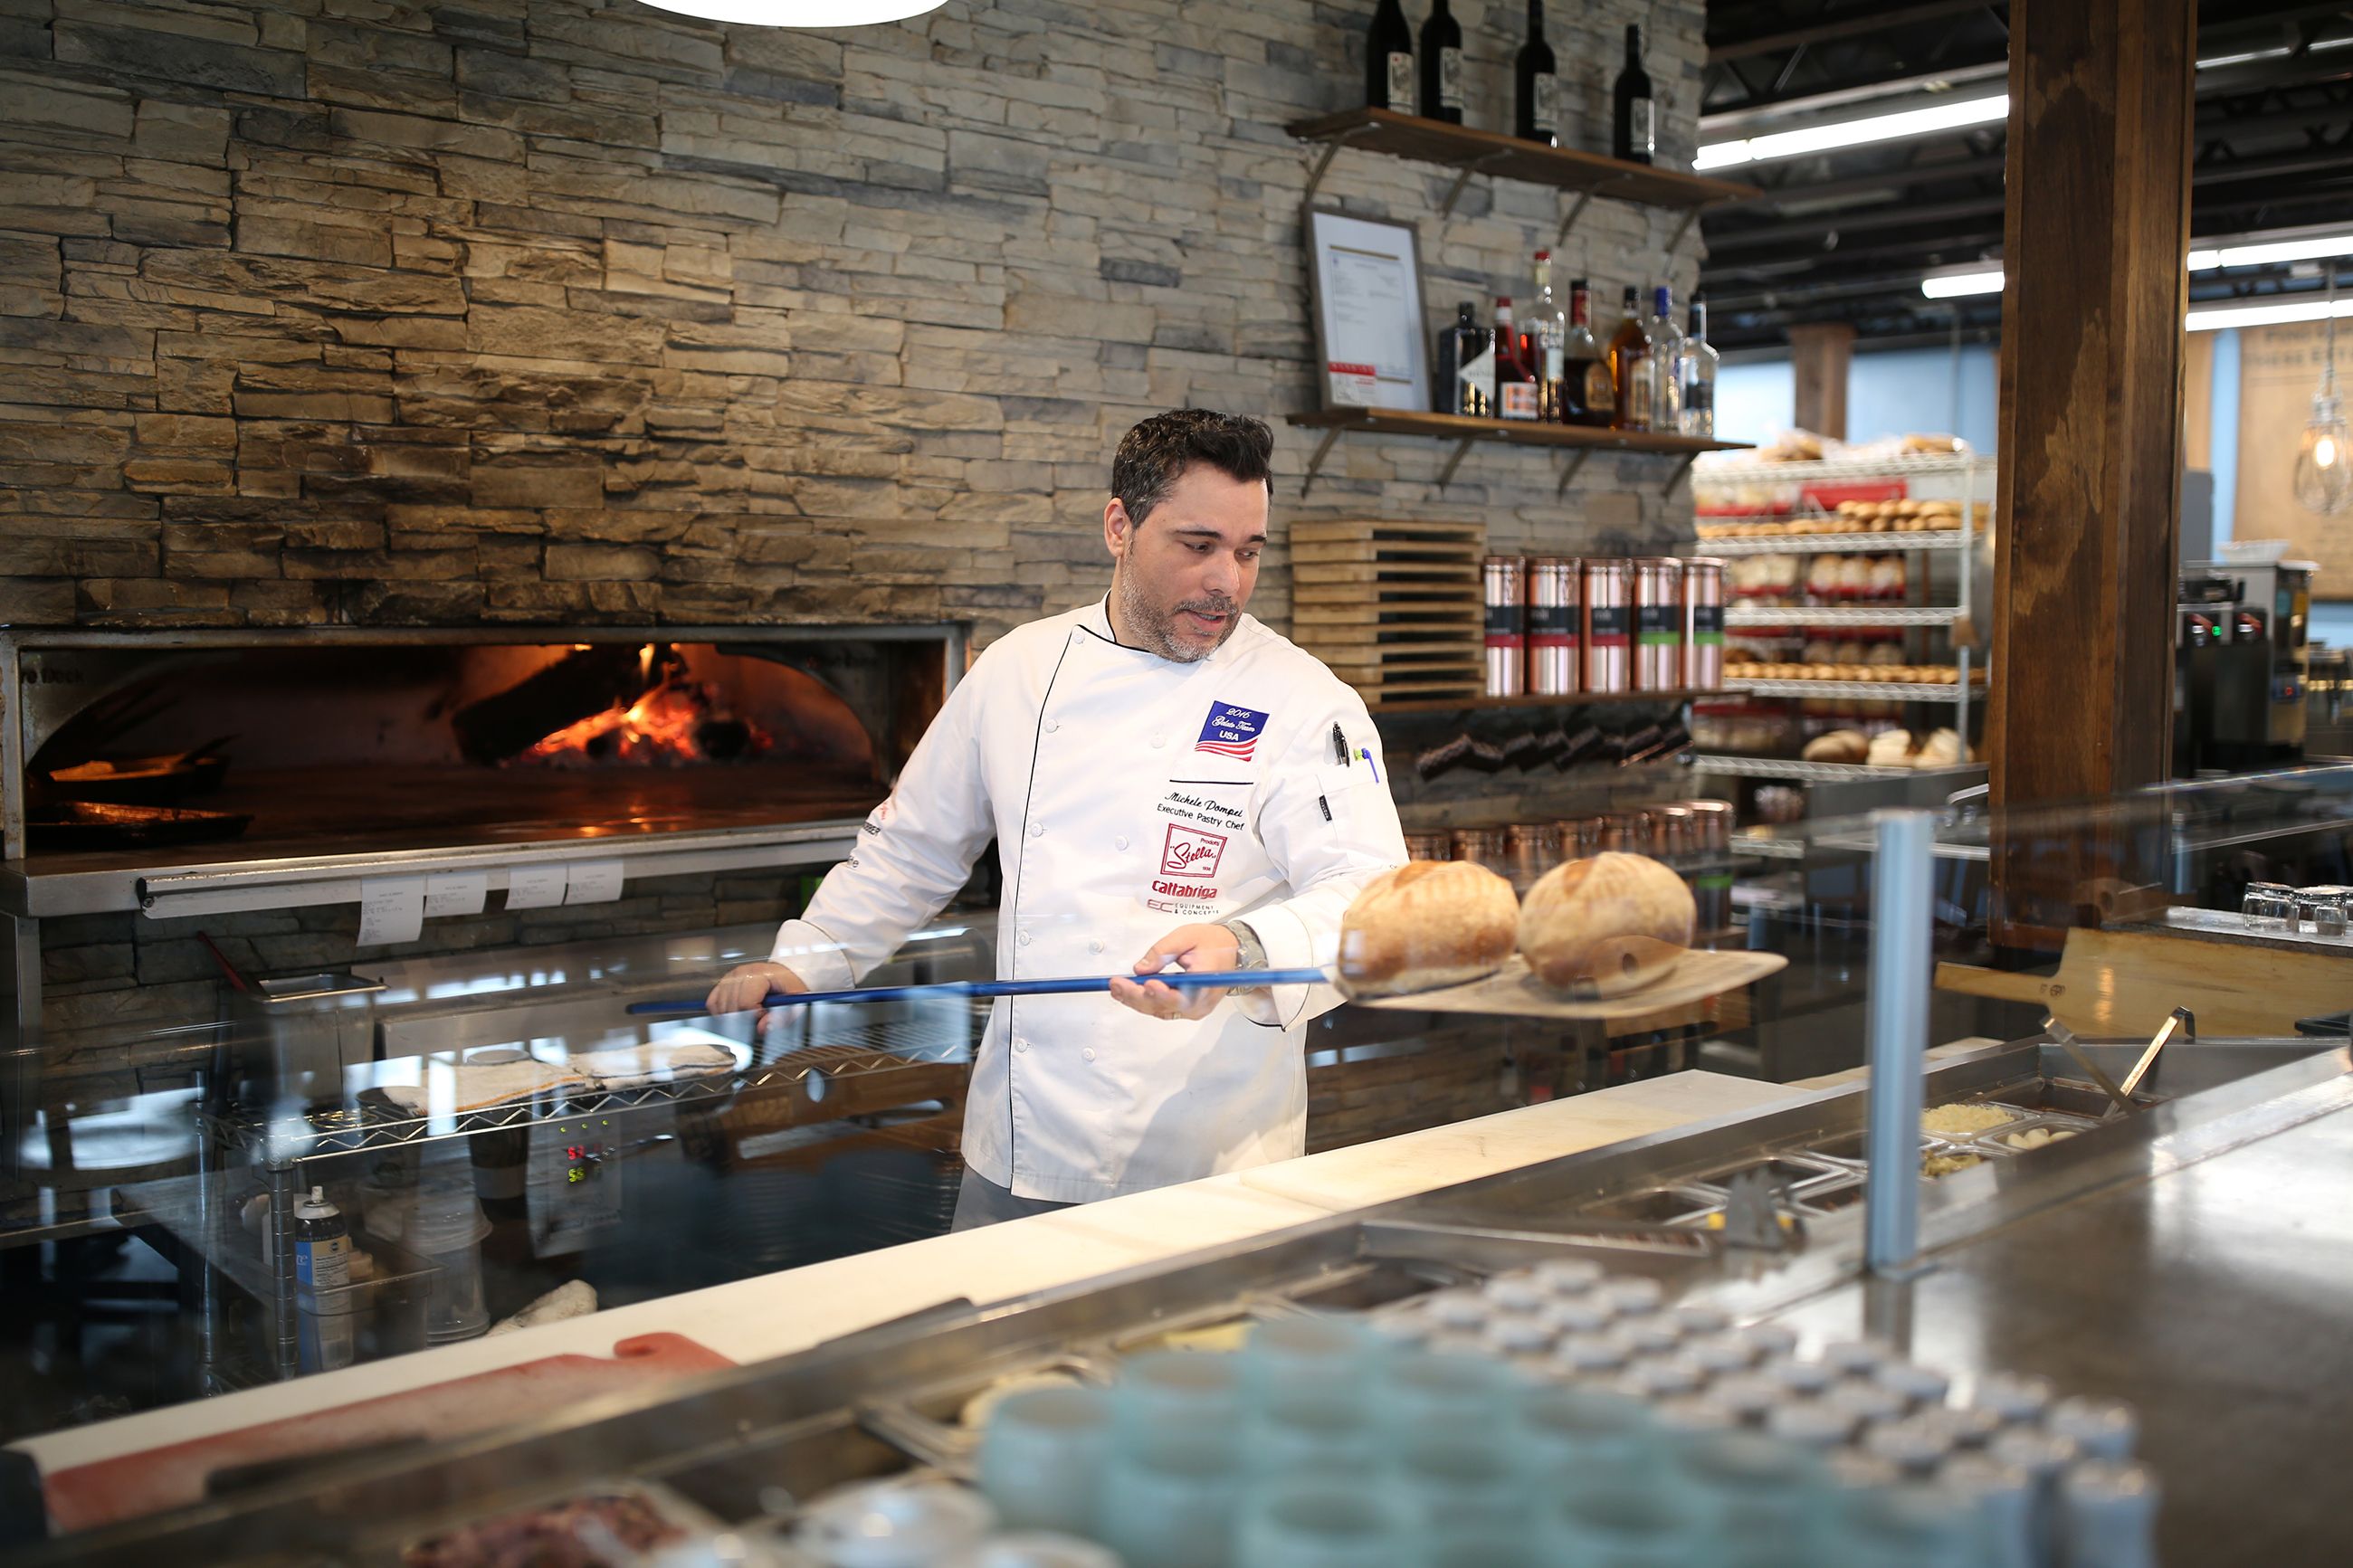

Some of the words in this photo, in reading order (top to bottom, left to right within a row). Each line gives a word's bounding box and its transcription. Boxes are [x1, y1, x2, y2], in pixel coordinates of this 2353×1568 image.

[1219, 729, 1239, 741] USA
[1165, 792, 1202, 807] Michele
[1157, 803, 1194, 819] Executive
[1196, 813, 1223, 827] Pastry
[1225, 820, 1245, 831] Chef
